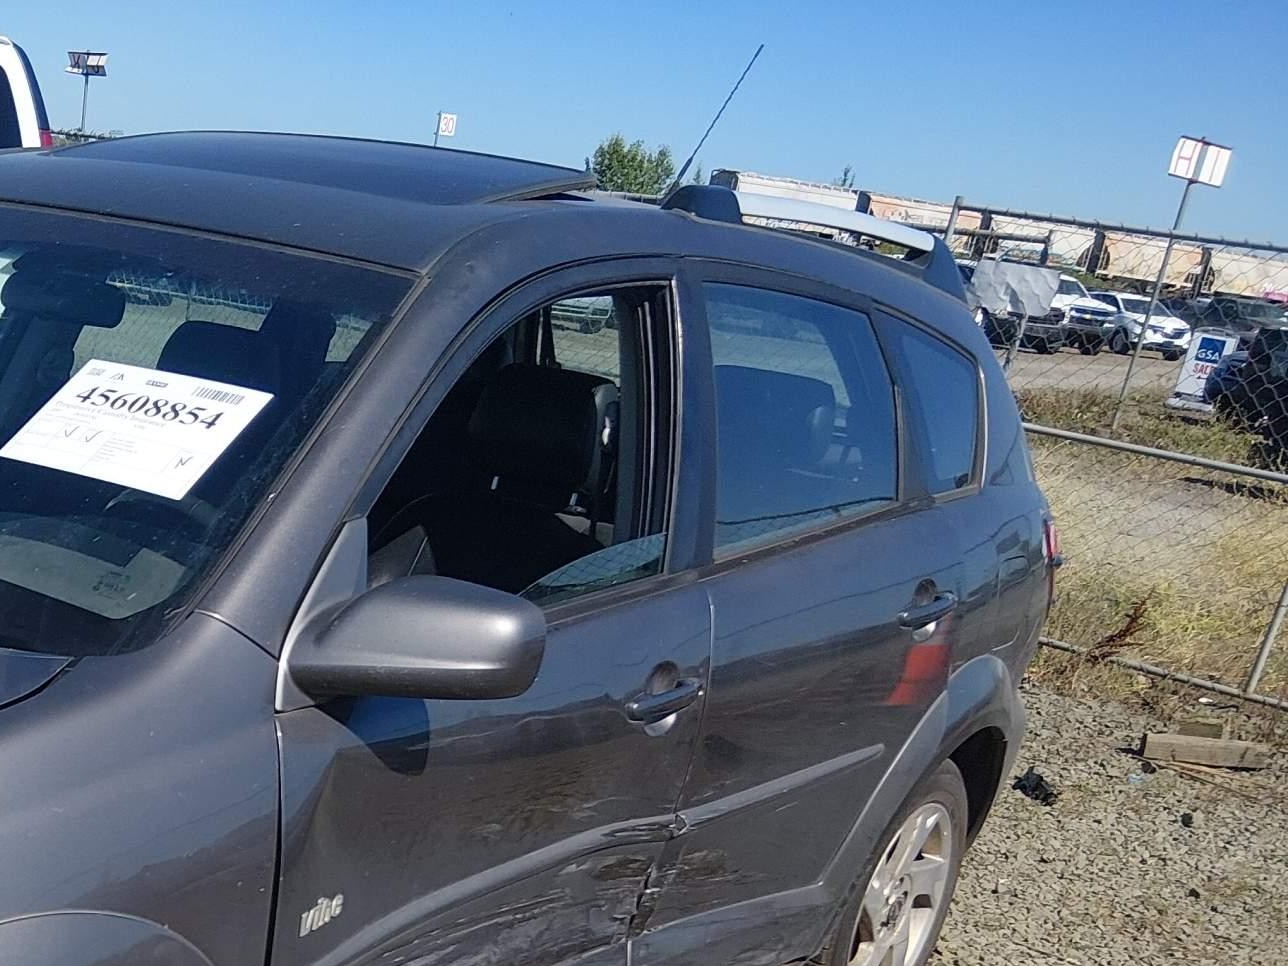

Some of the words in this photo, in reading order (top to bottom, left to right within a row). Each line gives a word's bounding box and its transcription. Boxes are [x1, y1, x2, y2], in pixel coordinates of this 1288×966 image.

[441, 116, 455, 134] 30
[1173, 139, 1198, 177] H
[1197, 348, 1220, 360] GSA
[75, 385, 226, 430] 45608854
